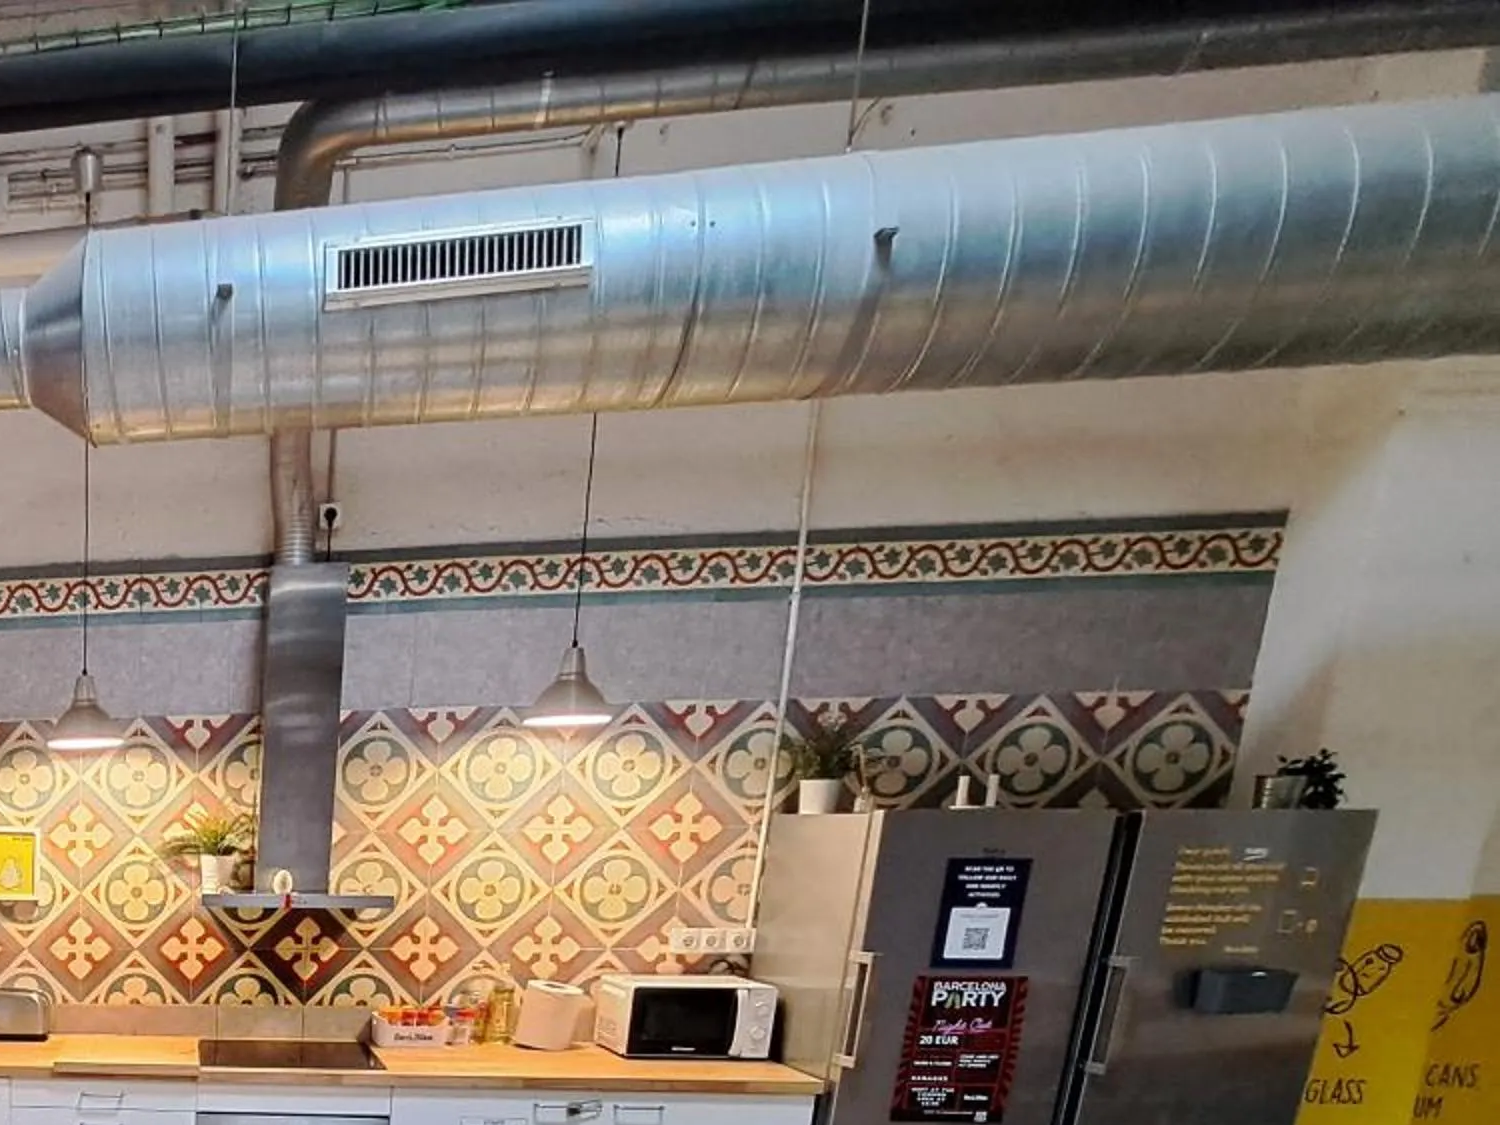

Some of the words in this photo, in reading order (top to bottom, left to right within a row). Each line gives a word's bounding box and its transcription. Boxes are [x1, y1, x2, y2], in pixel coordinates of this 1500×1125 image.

[933, 980, 1007, 992] BARCELONA
[931, 991, 1005, 1009] PARTY
[1425, 1062, 1481, 1089] CANS
[1304, 1078, 1367, 1105] GLASS
